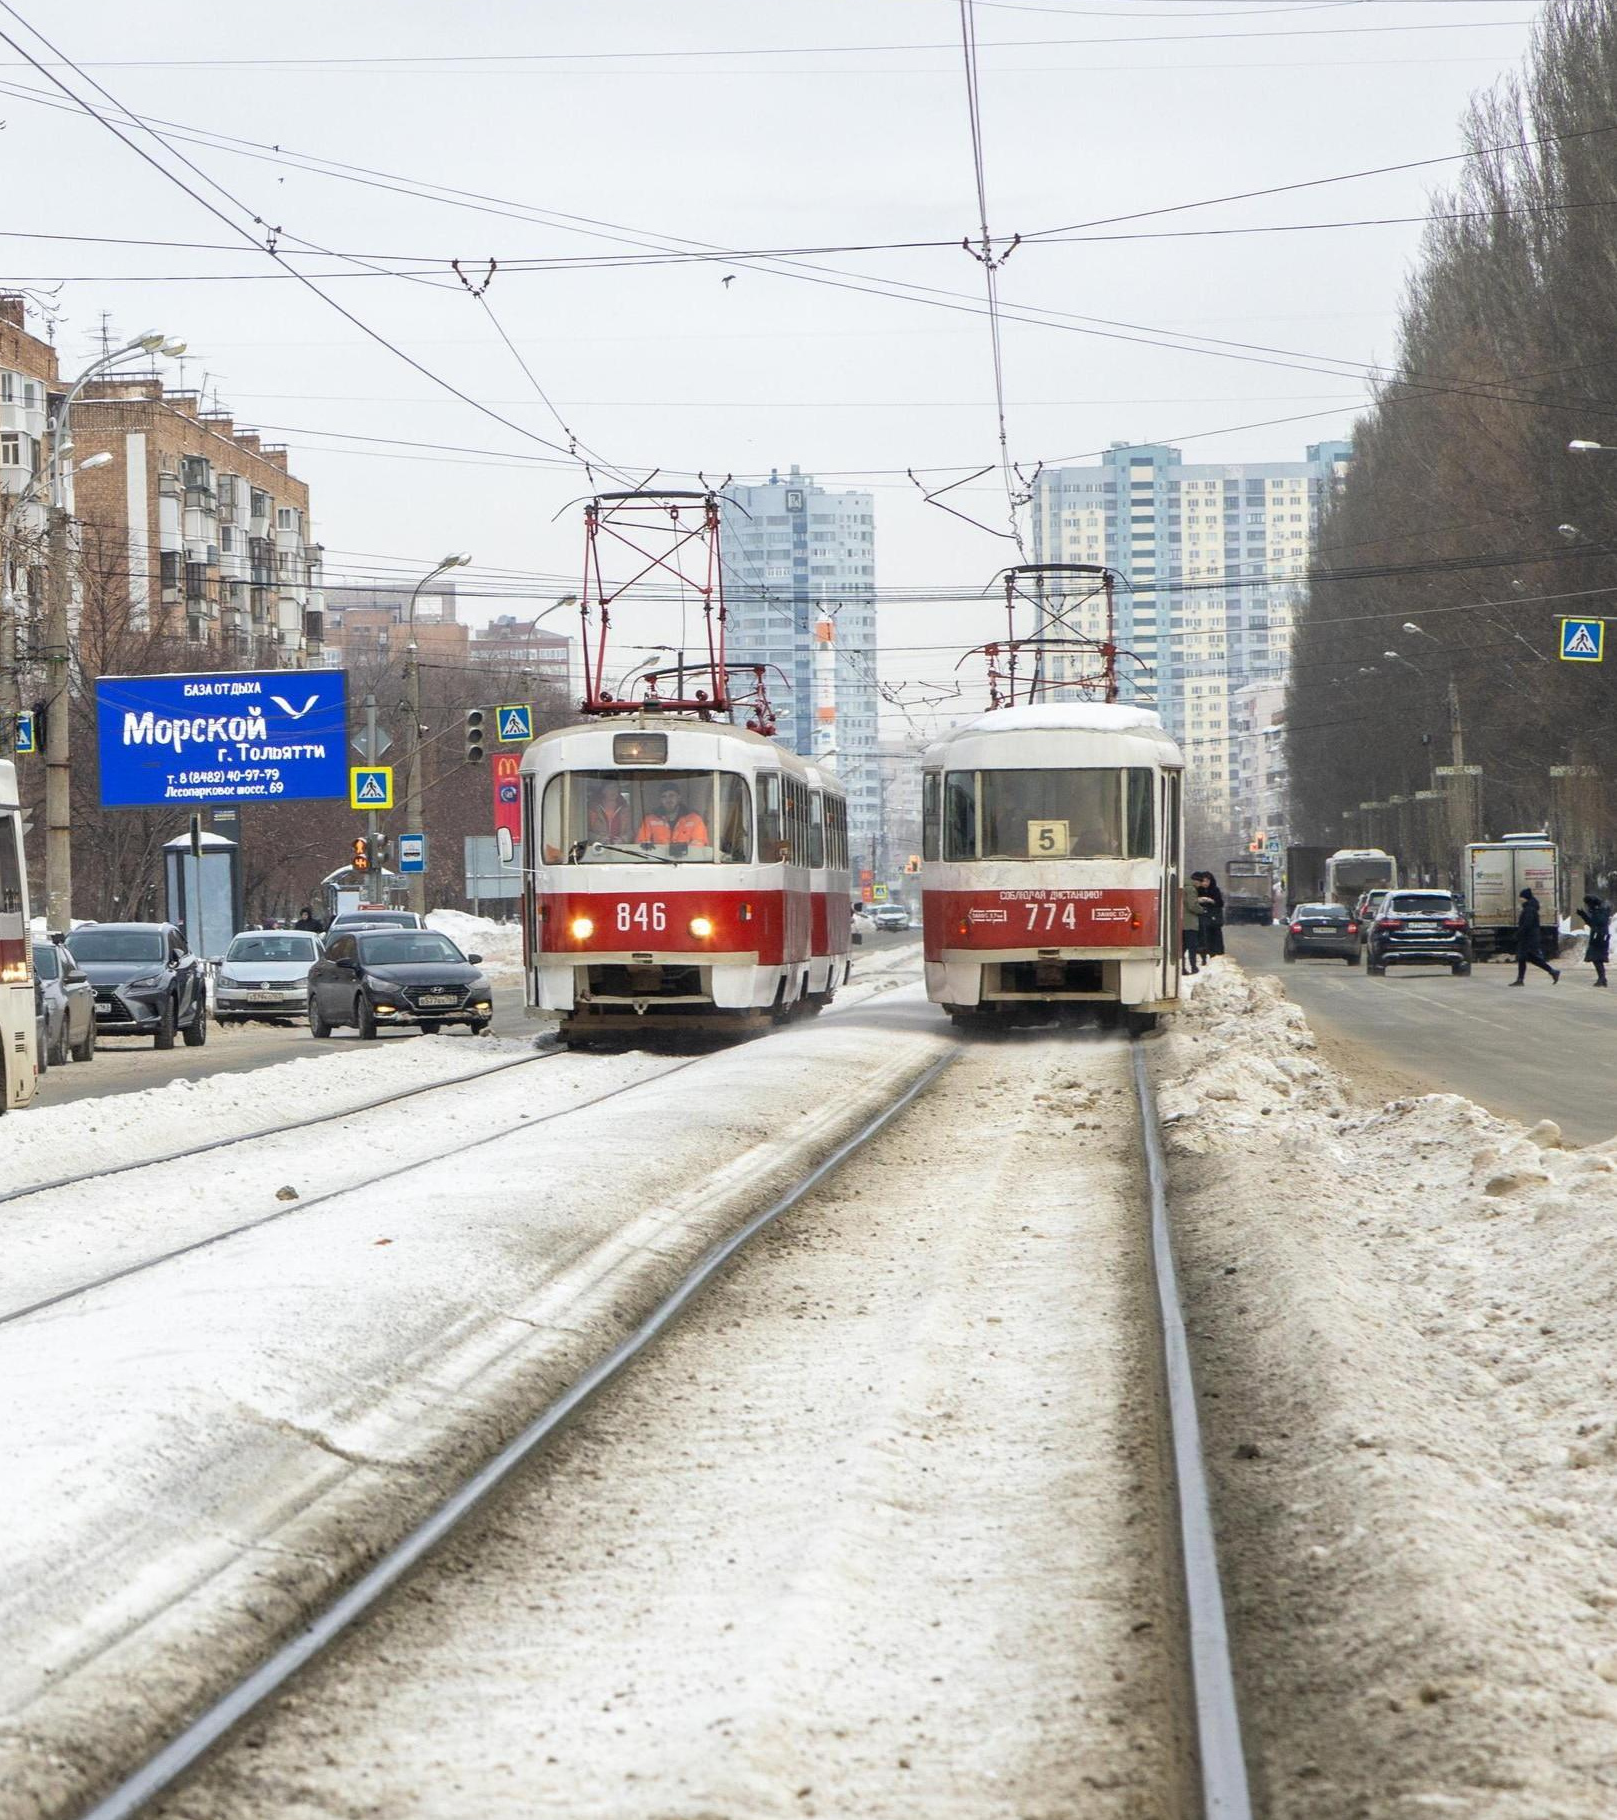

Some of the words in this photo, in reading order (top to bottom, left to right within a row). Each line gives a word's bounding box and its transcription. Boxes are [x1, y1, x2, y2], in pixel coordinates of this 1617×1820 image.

[184, 683, 213, 696] БАЗА
[214, 681, 262, 696] ОТДЫХА
[123, 706, 267, 753] Морской
[218, 748, 232, 762] г.
[236, 743, 326, 761] Тольятти
[180, 772, 187, 784] 8
[189, 771, 224, 784] (8482)
[227, 769, 280, 781] 40-97-79
[164, 785, 235, 799] Лесопарковое
[269, 782, 284, 793] 69
[1038, 828, 1055, 850] 5
[616, 902, 666, 931] 846
[1025, 903, 1076, 930] 774
